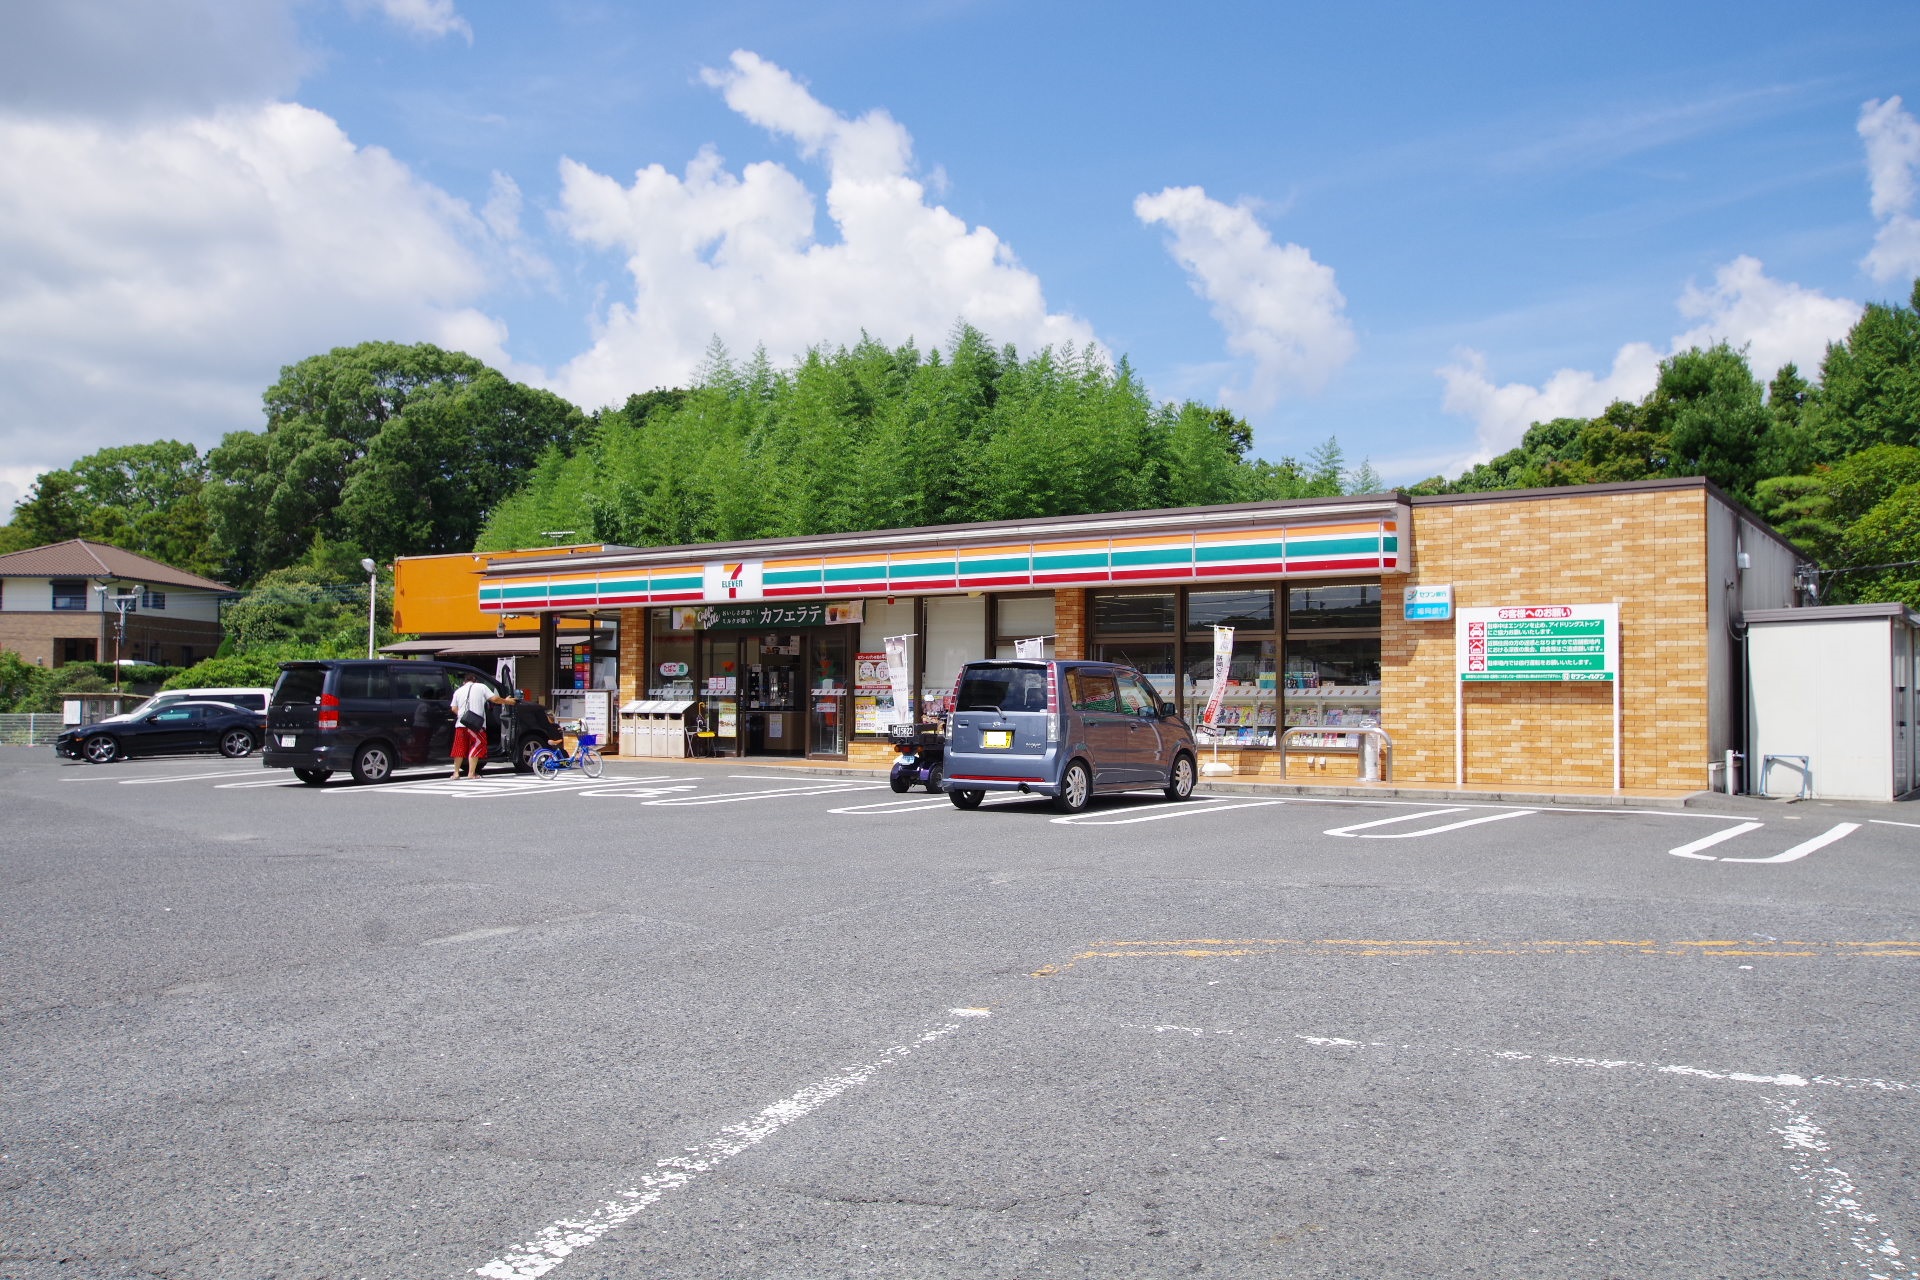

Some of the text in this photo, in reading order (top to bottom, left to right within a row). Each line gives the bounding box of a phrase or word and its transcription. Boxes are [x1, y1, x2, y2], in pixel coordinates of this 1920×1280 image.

[723, 563, 743, 598] 7
[760, 605, 822, 625] カフェラテ
[1498, 607, 1572, 619] お客様へのお願い
[663, 664, 677, 673] たばこ
